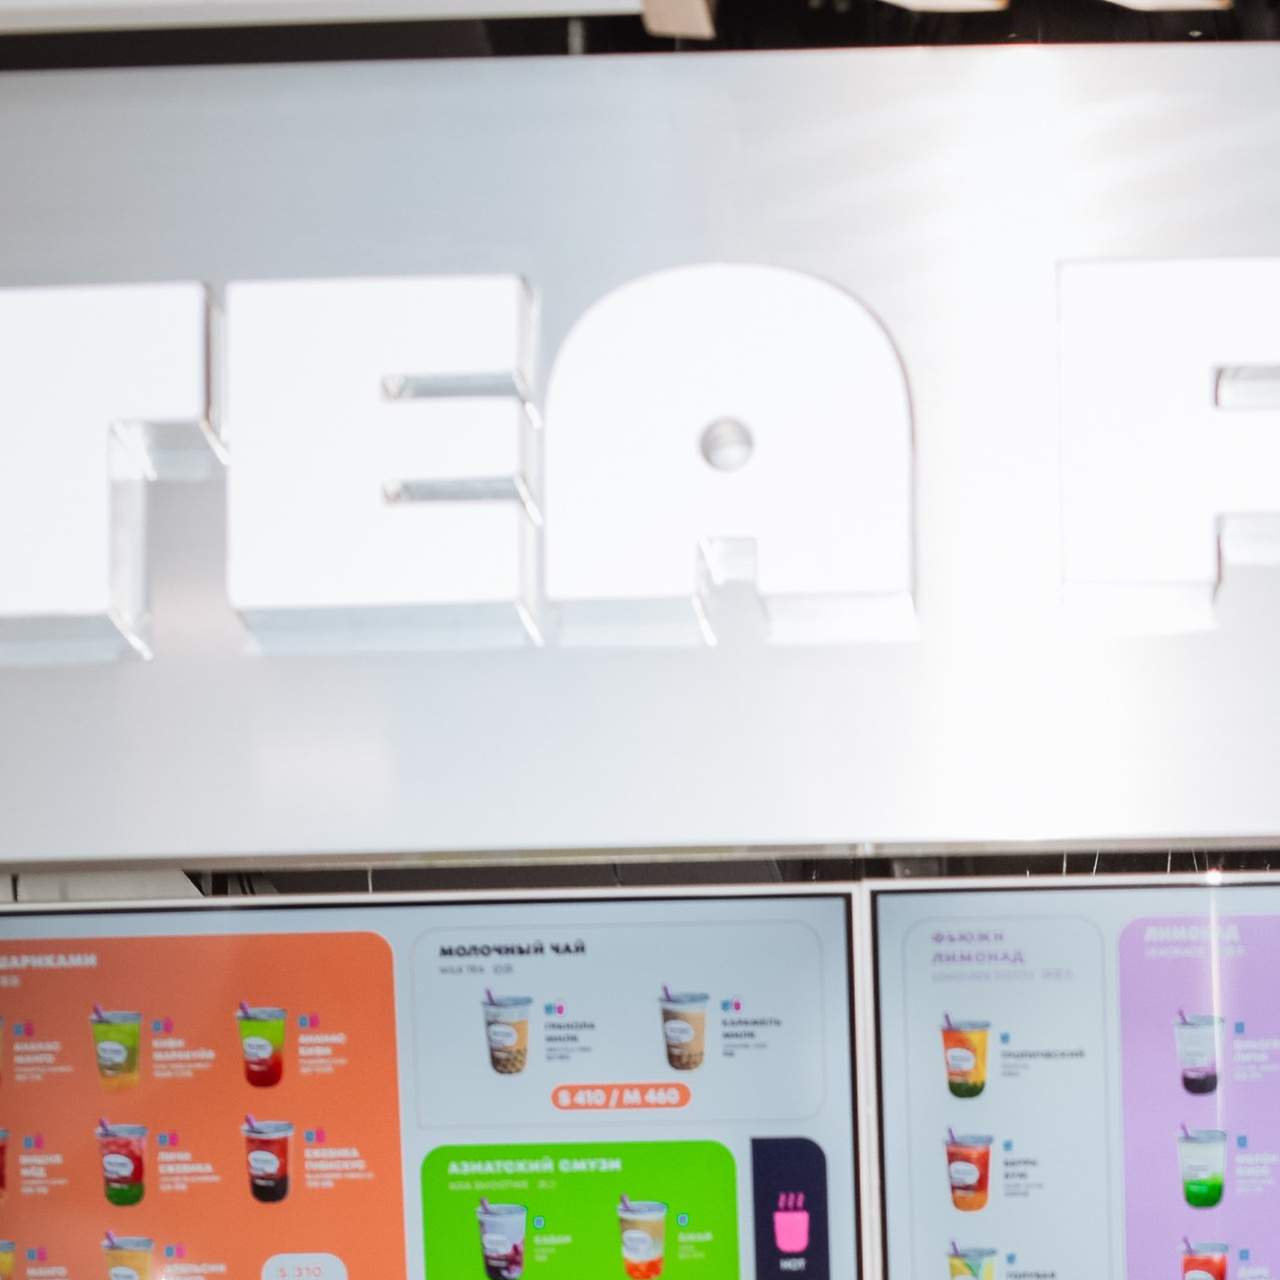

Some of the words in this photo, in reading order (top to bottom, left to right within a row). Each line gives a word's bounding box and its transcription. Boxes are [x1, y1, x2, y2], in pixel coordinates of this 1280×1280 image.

[439, 941, 544, 957] МОЛОЧНЫЙ
[550, 939, 586, 955] ЧАЙ
[932, 951, 1024, 964] ЛИМОНАД
[622, 1088, 642, 1105] M
[448, 1157, 554, 1175] АЗИАТСКИЙ
[559, 1158, 622, 1172] СМУЗИ
